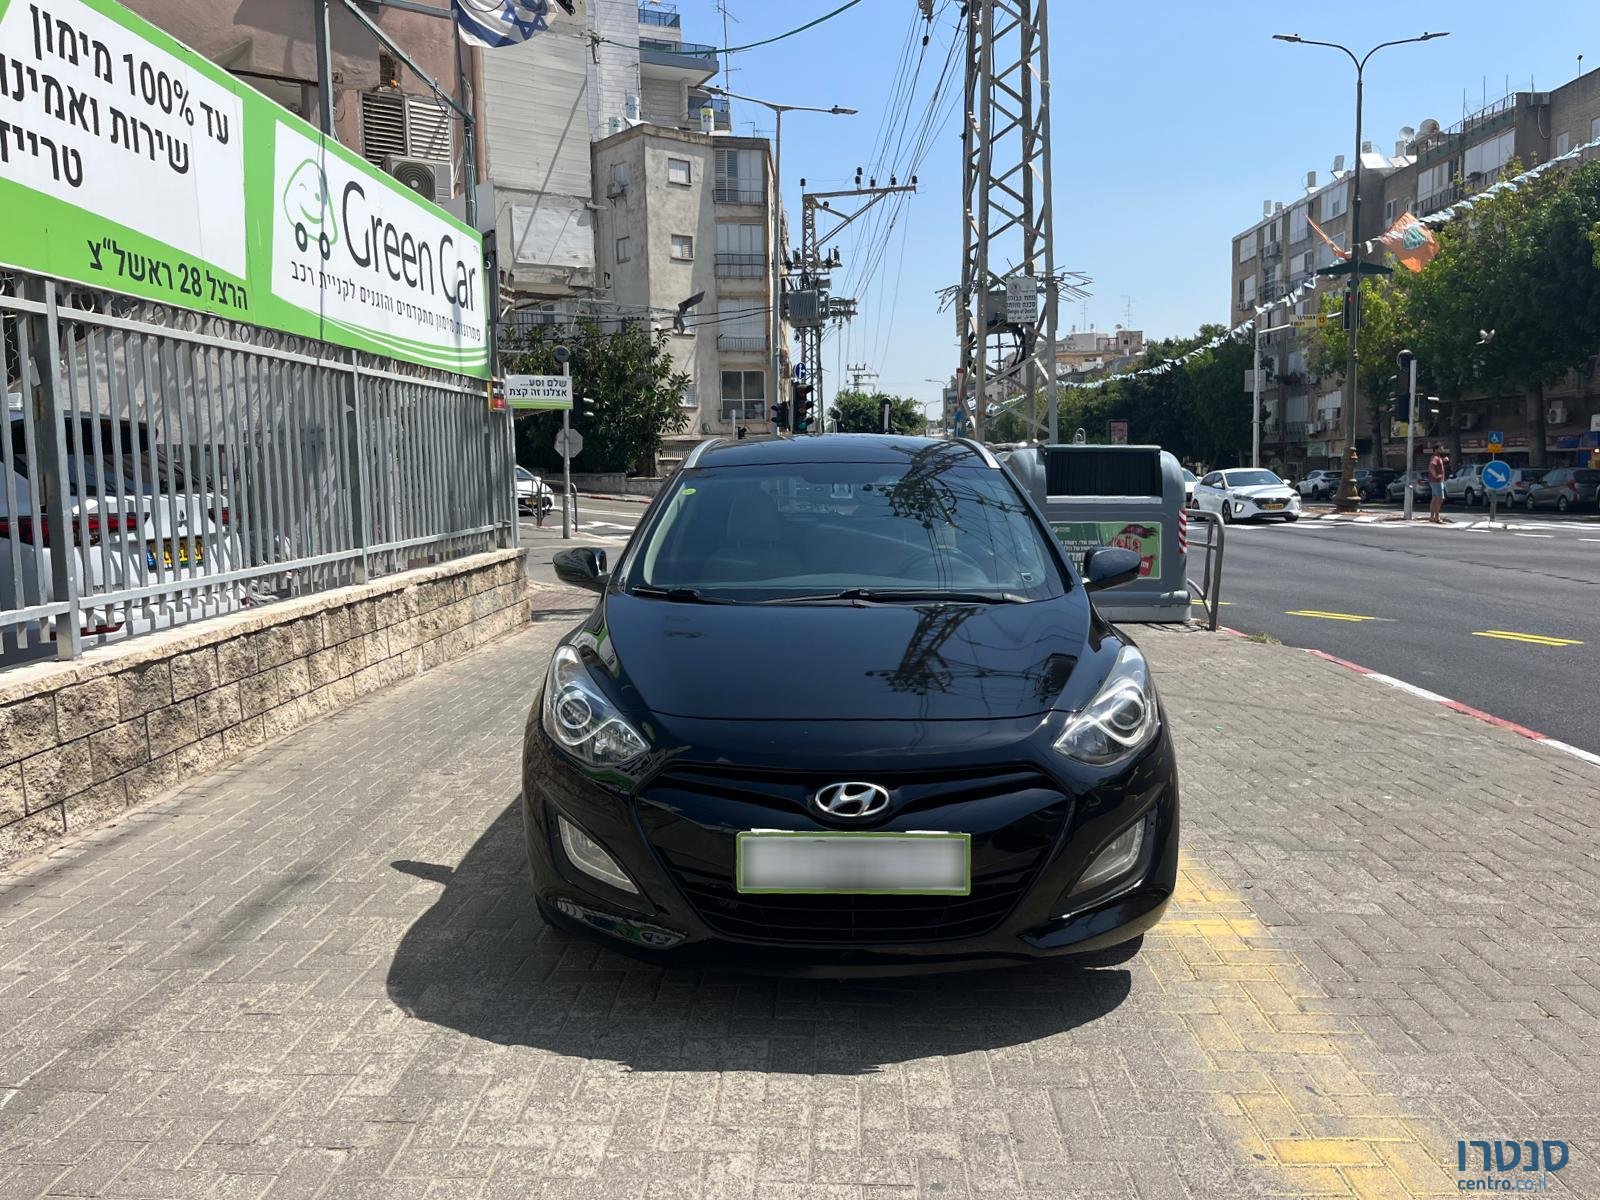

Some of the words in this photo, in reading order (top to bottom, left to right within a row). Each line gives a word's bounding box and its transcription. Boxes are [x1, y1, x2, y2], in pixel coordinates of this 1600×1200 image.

[30, 3, 113, 84] מימון
[123, 54, 194, 126] 100%
[200, 101, 229, 145] עד
[109, 106, 189, 174] שירות
[342, 181, 434, 295] Green
[440, 235, 475, 311] Car
[178, 263, 202, 297] 28
[291, 260, 315, 286] רכב
[319, 271, 356, 302] לקניית
[206, 270, 247, 310] הרצל
[360, 286, 394, 313] והוגנים
[397, 300, 434, 326] מתקדמים
[436, 313, 455, 331] מימון
[509, 388, 528, 398] קצת
[531, 388, 541, 396] זה
[543, 388, 568, 398] אצלנו
[547, 378, 567, 387] שלם
